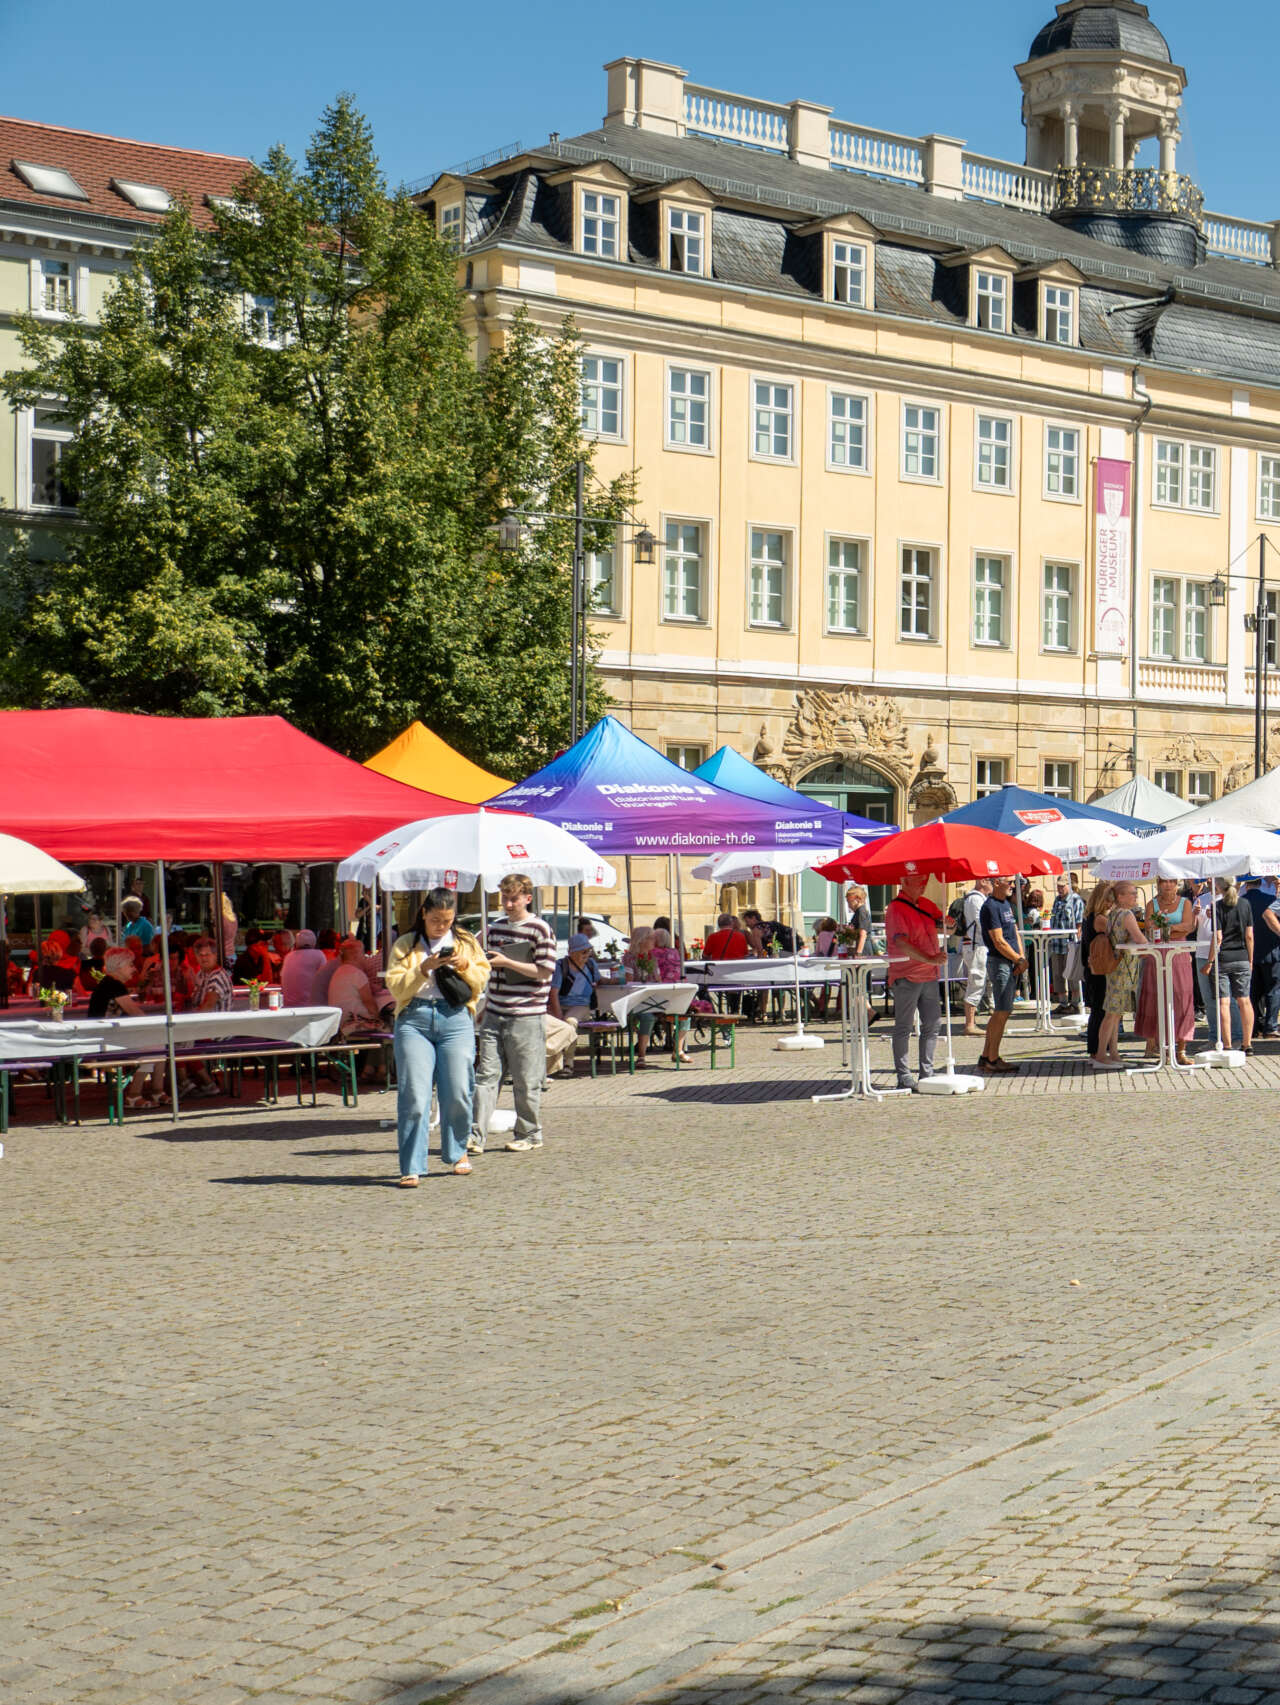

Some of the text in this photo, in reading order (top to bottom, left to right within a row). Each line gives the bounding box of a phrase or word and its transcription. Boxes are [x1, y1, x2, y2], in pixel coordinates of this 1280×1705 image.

[1108, 529, 1117, 588] MUSEUM
[1098, 528, 1107, 603] THÜRINGER
[596, 783, 695, 795] Diakonie
[561, 822, 603, 831] Diakonie
[776, 821, 813, 830] Diakonie
[635, 832, 756, 846] www.diakonie-th.de
